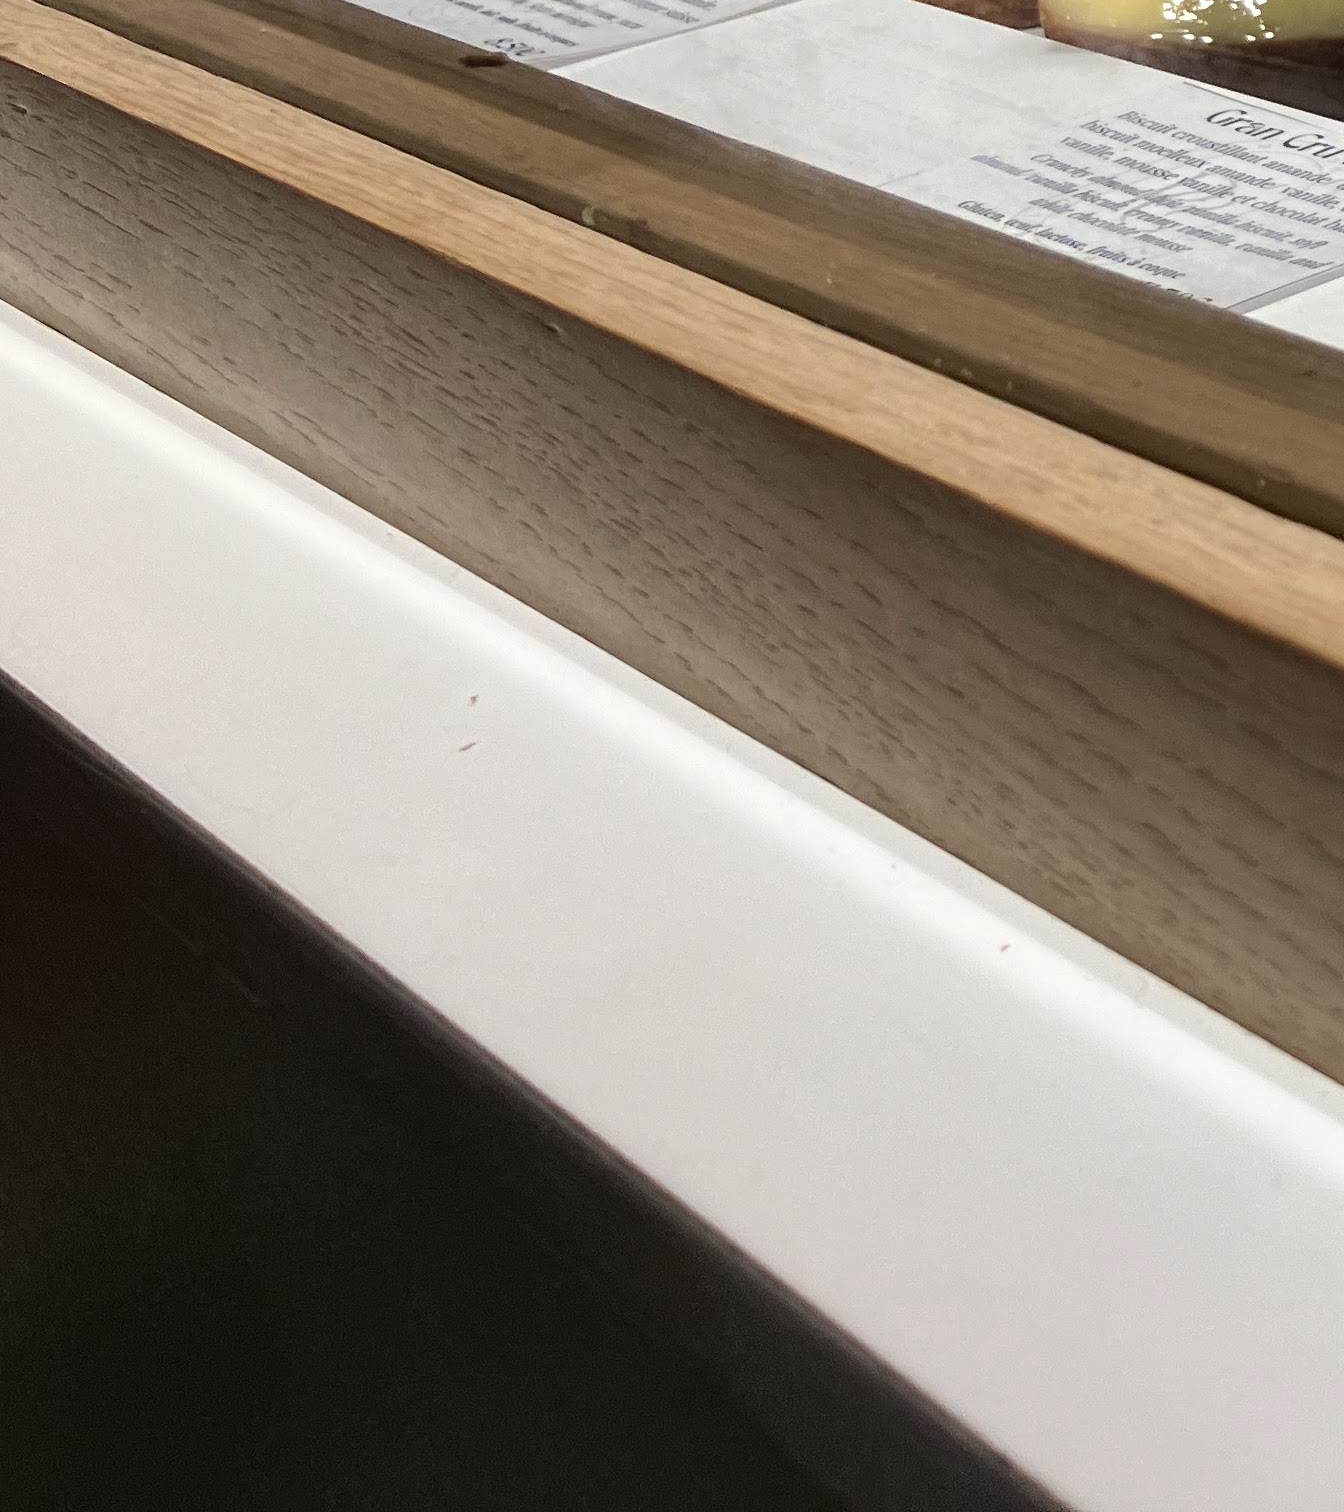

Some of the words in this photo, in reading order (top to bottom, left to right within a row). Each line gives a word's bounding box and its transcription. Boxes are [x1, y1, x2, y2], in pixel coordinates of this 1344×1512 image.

[1115, 110, 1179, 135] Biscuit
[1171, 130, 1270, 165] croustillant
[1205, 109, 1285, 141] Gran
[1079, 119, 1141, 145] biscuit
[1131, 139, 1211, 169] moelleux
[1281, 186, 1341, 210] vanille,
[1112, 156, 1181, 181] mousse
[1173, 174, 1236, 199] vanille
[1230, 195, 1258, 205] et
[1249, 200, 1330, 226] chocolat
